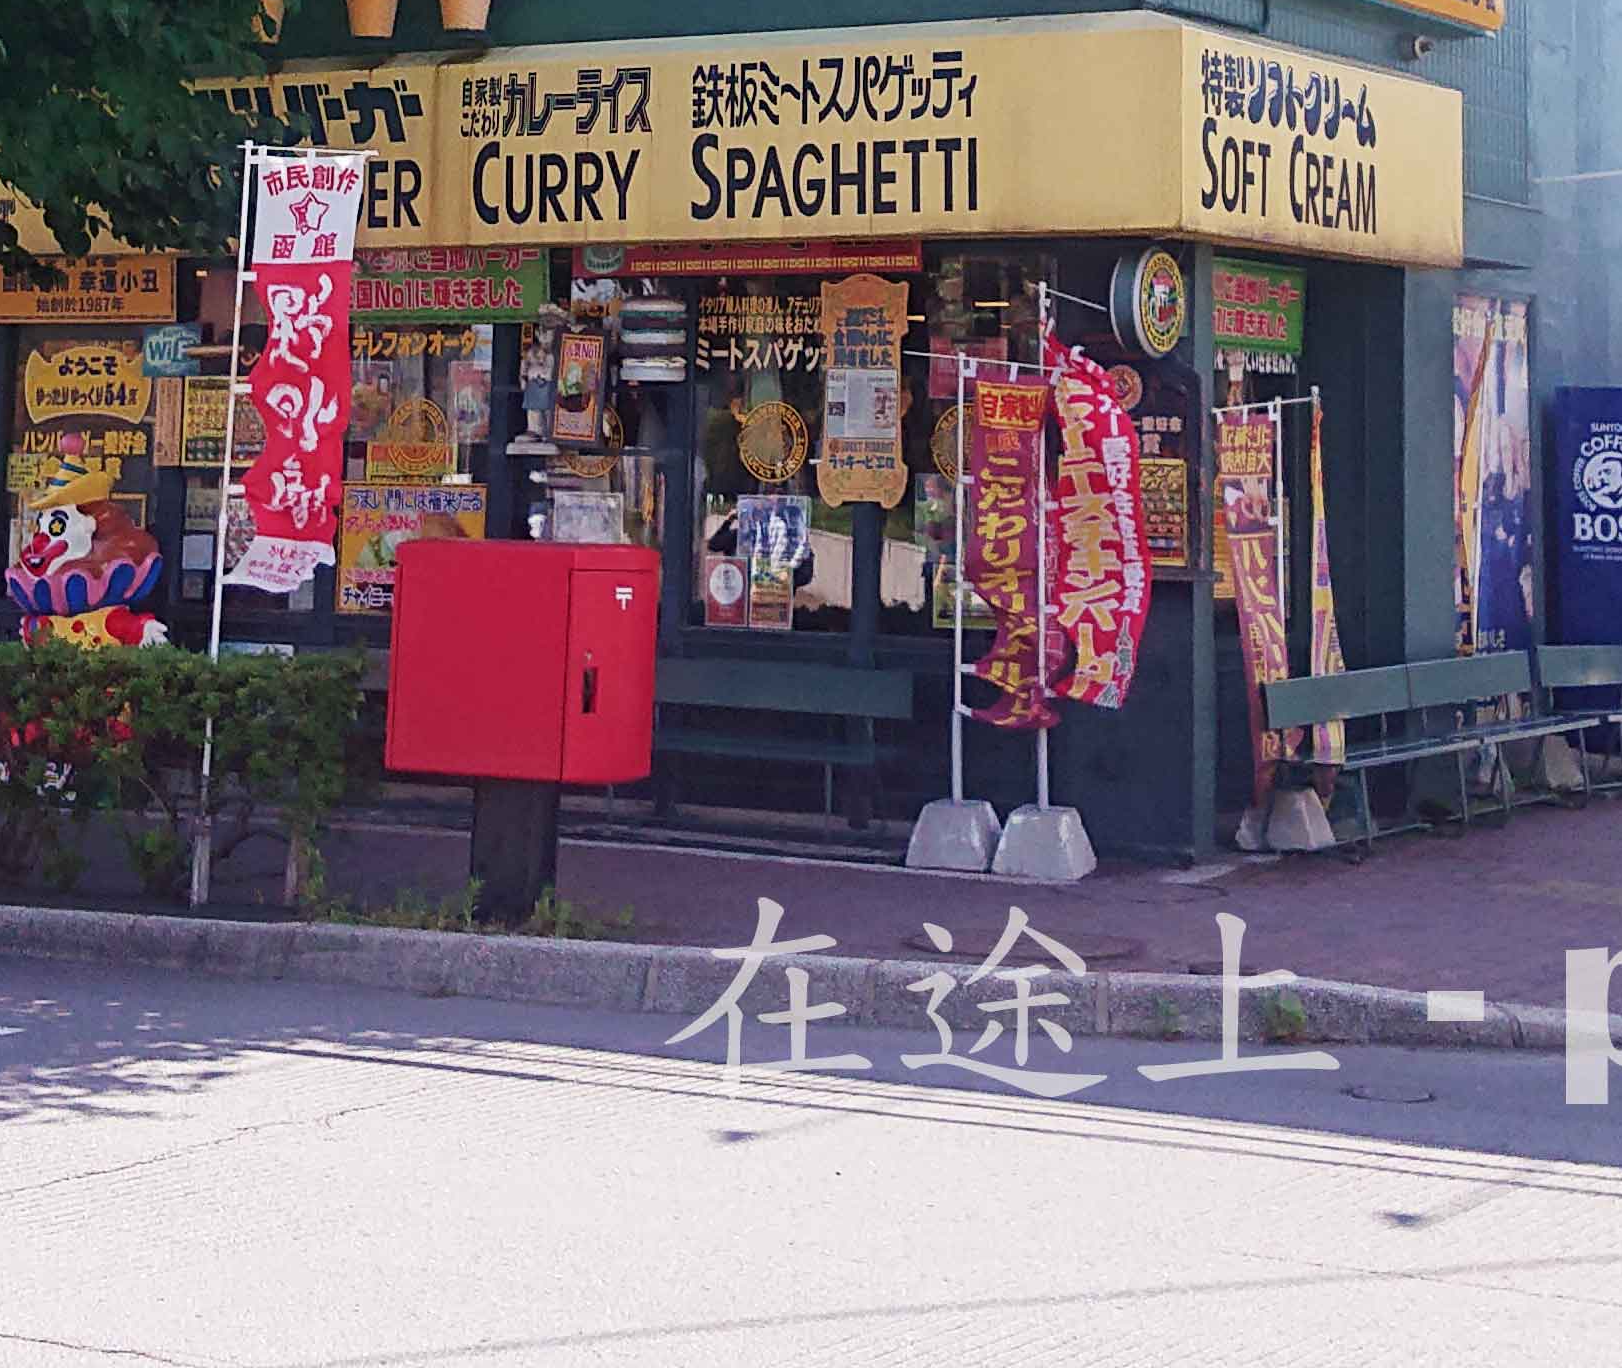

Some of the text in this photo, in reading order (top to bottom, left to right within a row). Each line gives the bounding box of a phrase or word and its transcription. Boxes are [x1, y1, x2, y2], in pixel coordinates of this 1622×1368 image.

[502, 65, 653, 137] カレーライス
[691, 50, 978, 129] 鉄板ミートスパゲッティ
[1201, 47, 1377, 149] 特製ソフトクリーム
[263, 164, 360, 197] 市民創作
[472, 140, 641, 225] CURRY
[691, 132, 978, 220] SPAGHETTI
[1201, 116, 1377, 235] SOFT CREAM
[271, 232, 338, 259] 函館
[58, 355, 118, 377] ようこそ
[695, 335, 826, 372] ミートスパゲッ
